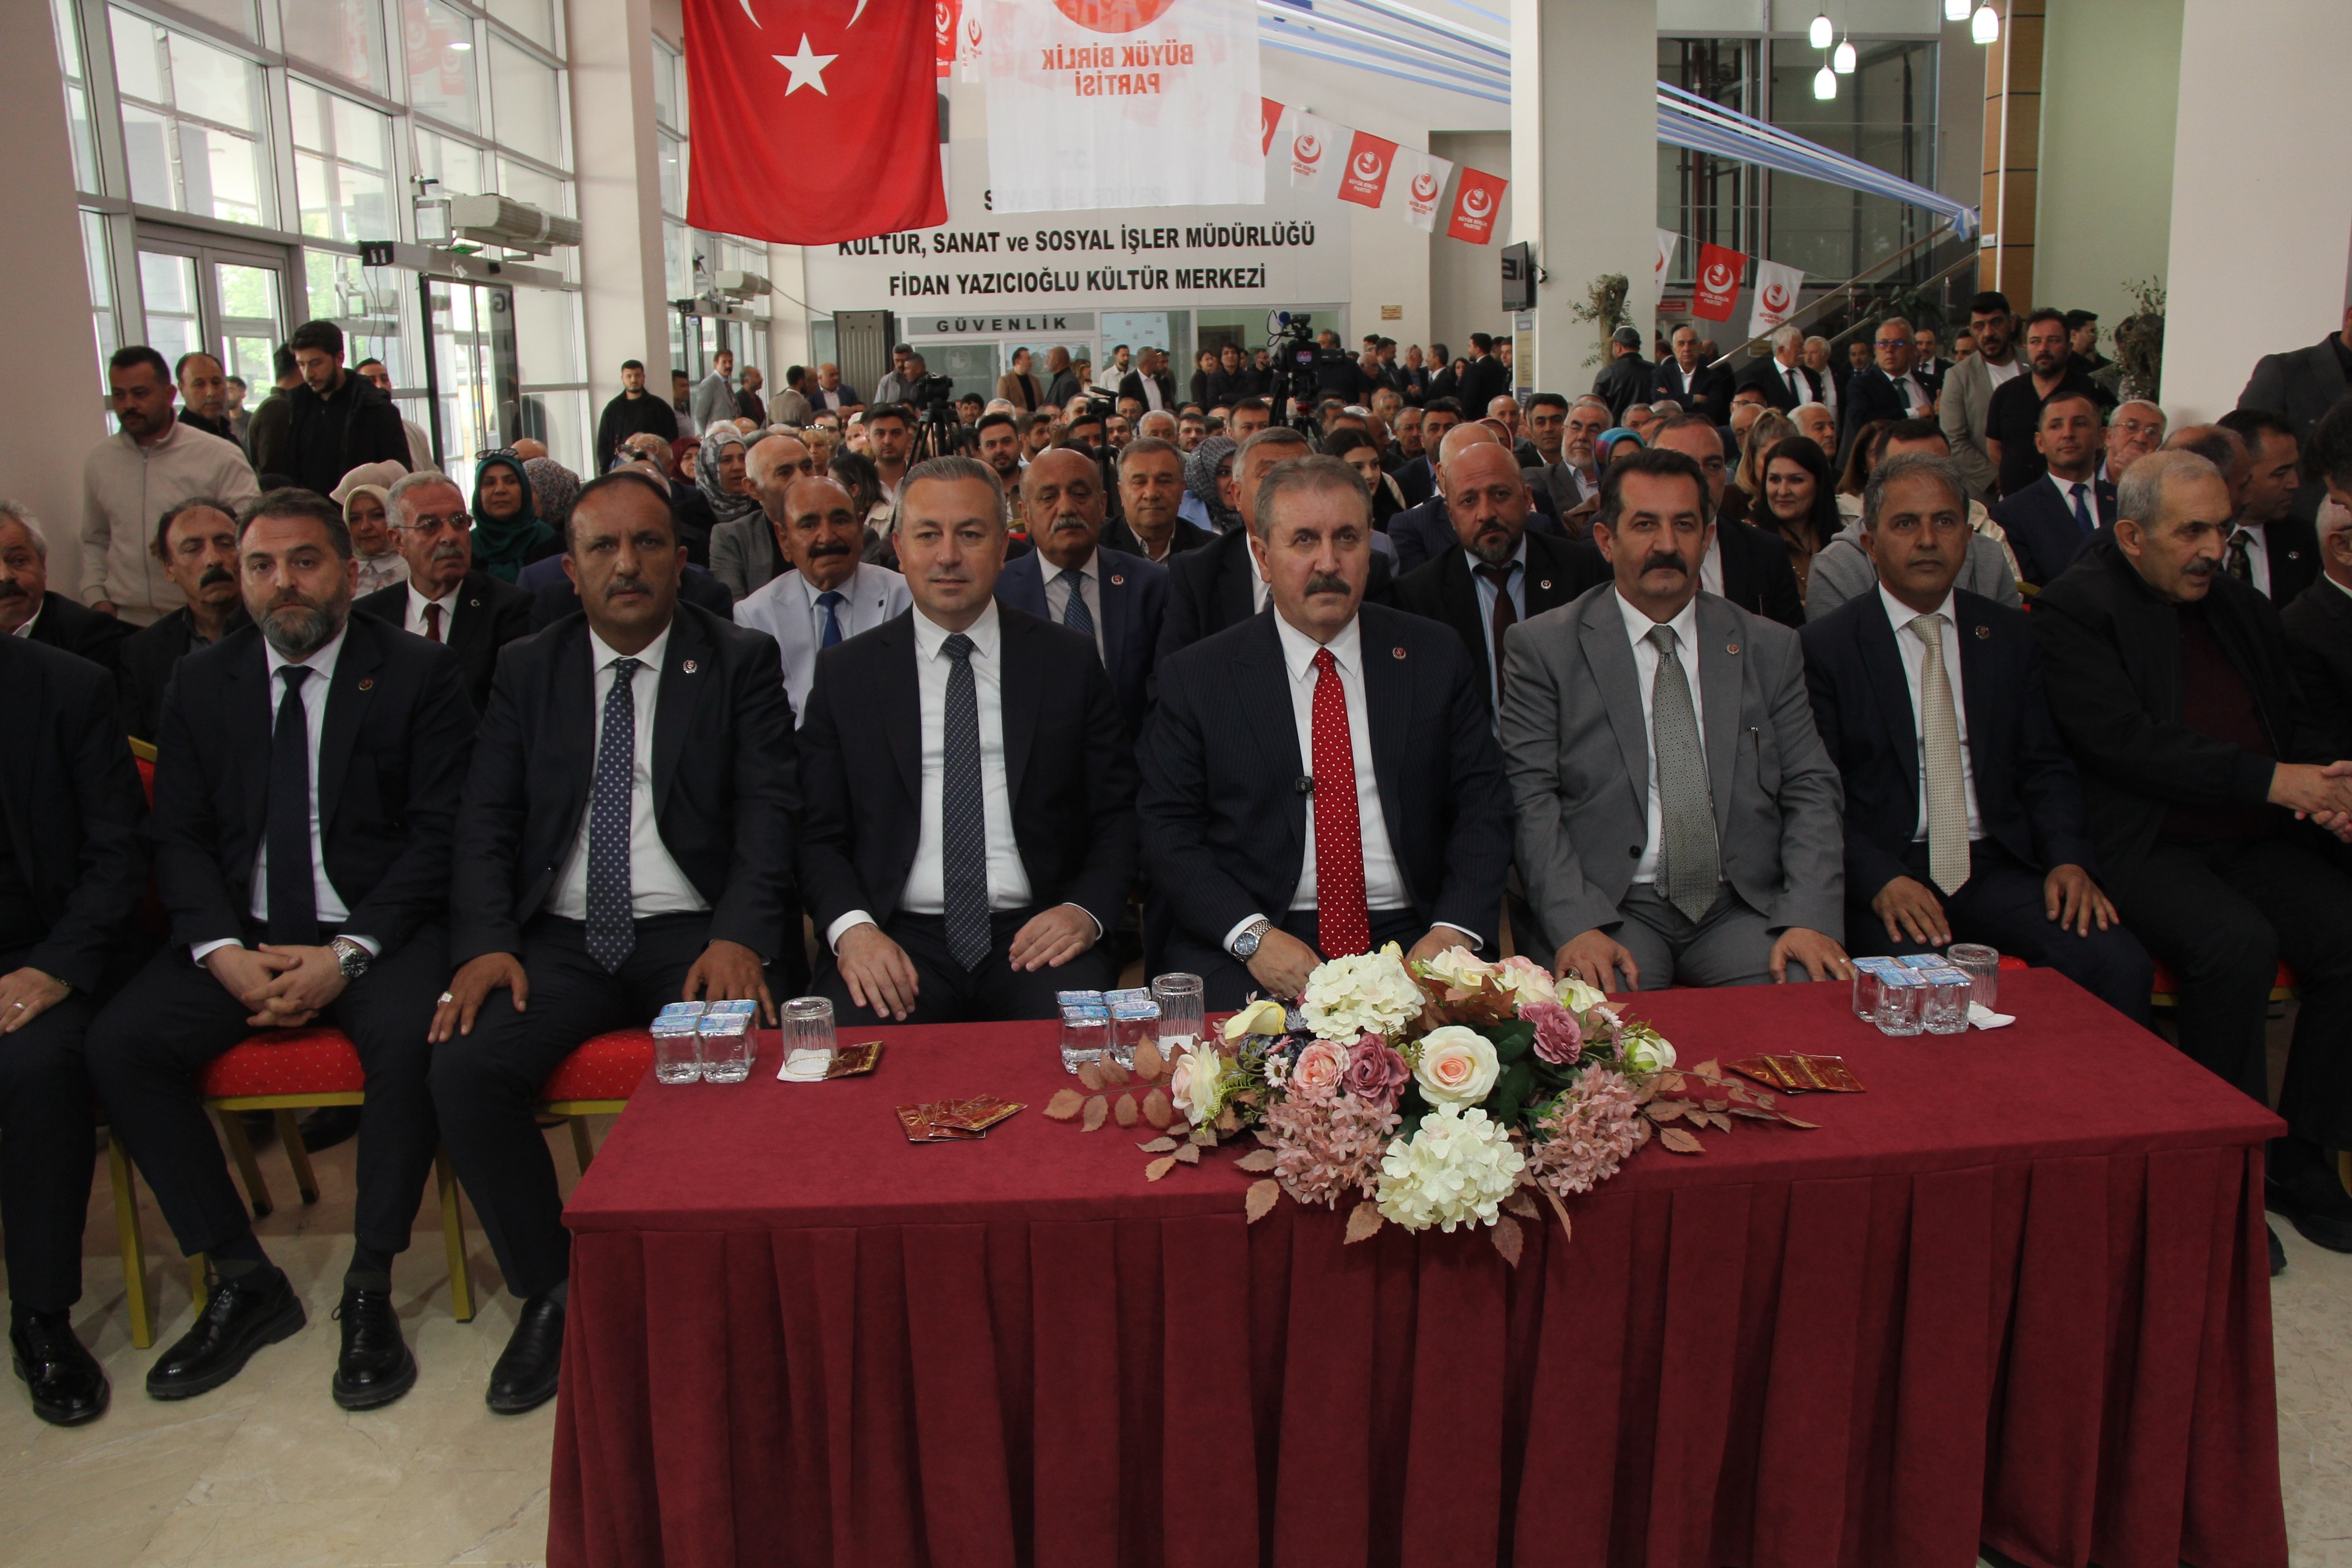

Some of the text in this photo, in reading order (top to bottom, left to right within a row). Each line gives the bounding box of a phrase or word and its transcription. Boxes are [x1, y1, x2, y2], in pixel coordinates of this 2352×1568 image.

[933, 231, 1000, 254] SANAT
[1006, 235, 1029, 251] ve
[1035, 229, 1114, 251] SOSYAL
[1121, 224, 1179, 255] İŞLER
[1186, 220, 1314, 248] MÜDÜRLÜĞÜ
[889, 263, 1265, 296] FİDAN YAZICIOĞLU KÜLTÜR MERKEZİ
[936, 315, 1066, 332] GÜVENLİK
